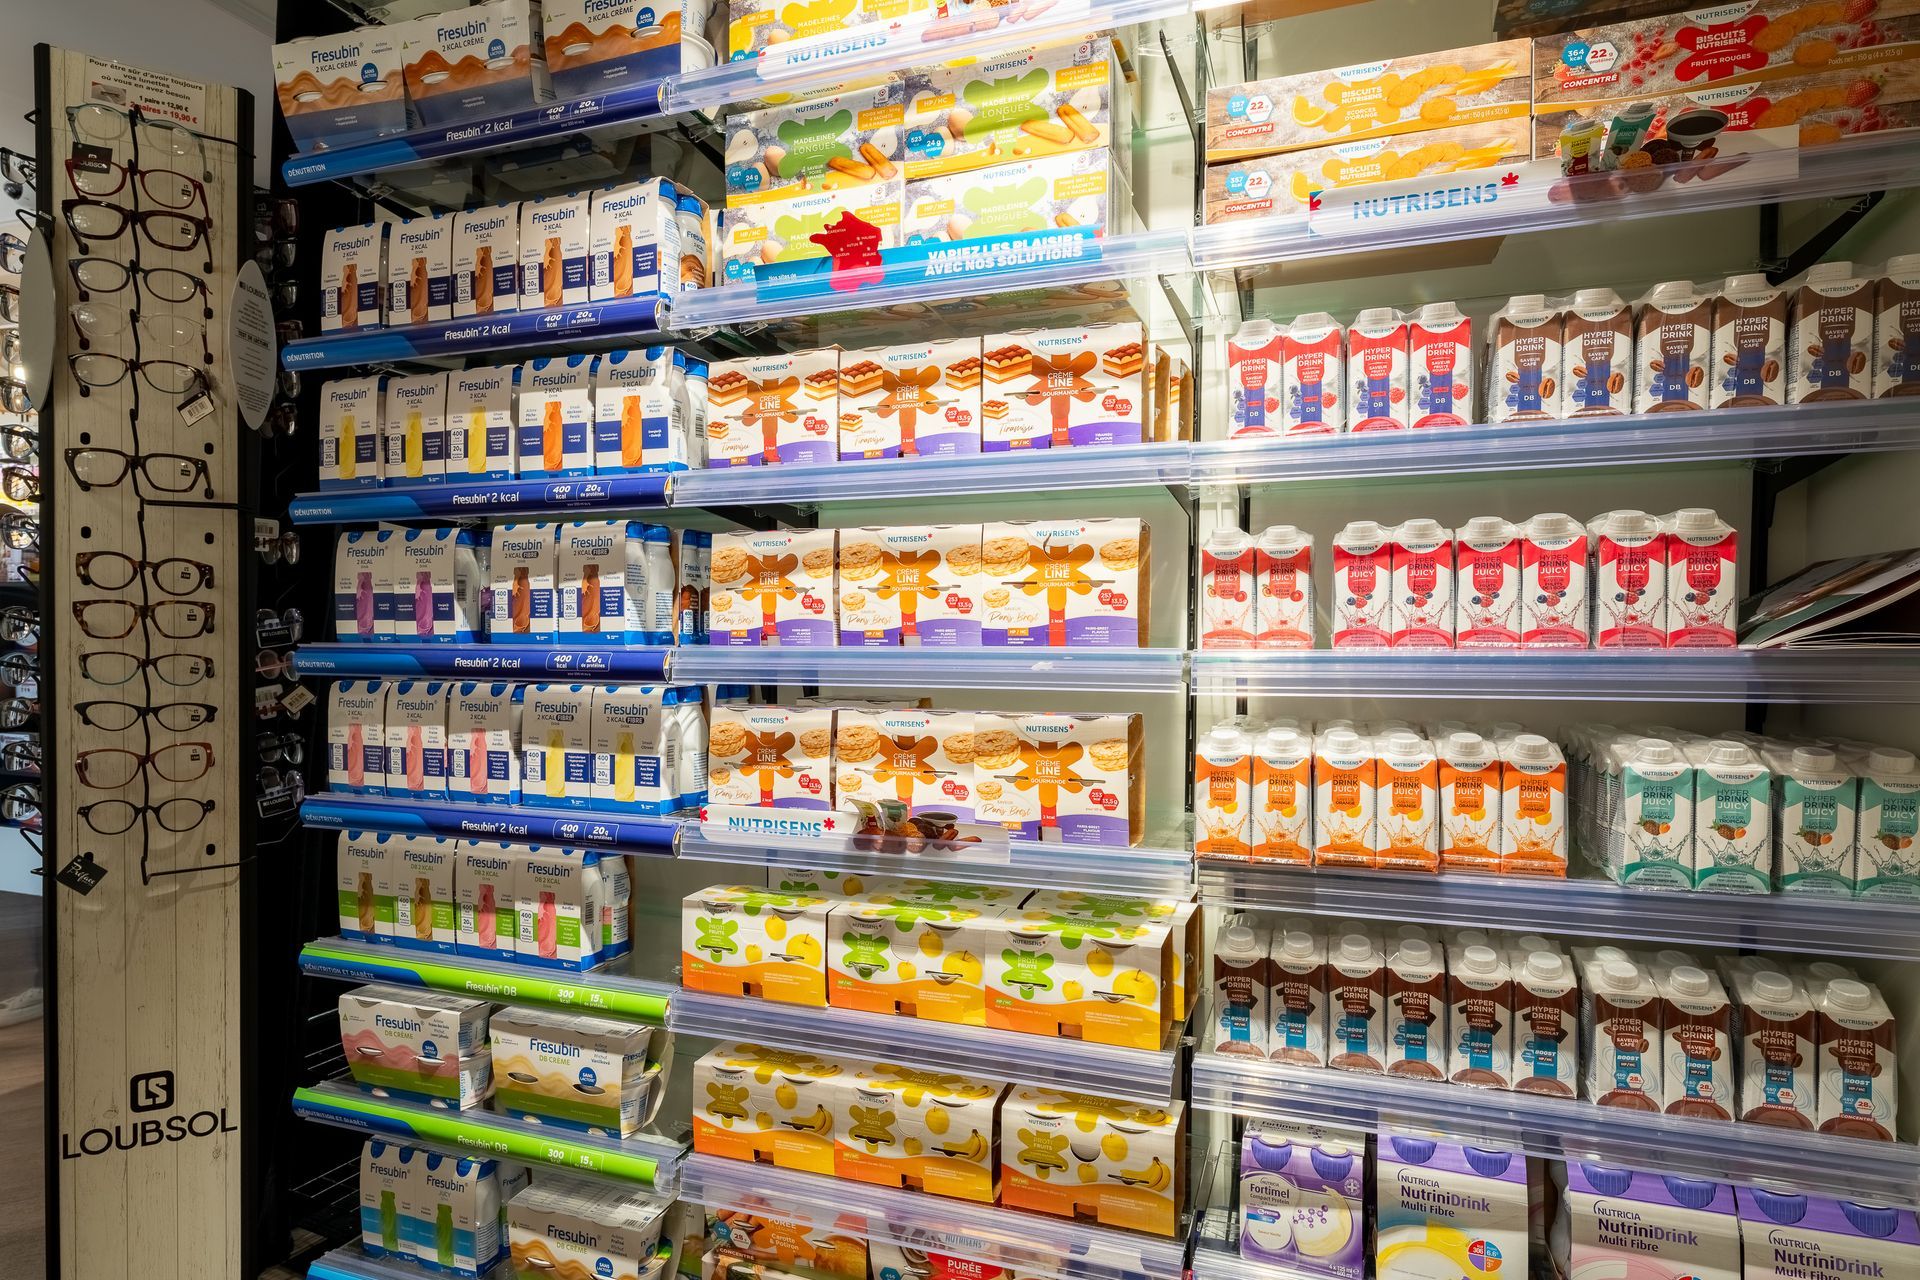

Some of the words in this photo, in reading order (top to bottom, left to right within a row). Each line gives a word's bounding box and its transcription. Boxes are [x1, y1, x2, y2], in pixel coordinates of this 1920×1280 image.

[1696, 6, 1746, 21] NUTRISENS
[1696, 28, 1746, 45] BISCUITS
[786, 31, 888, 65] NUTRISENS
[1696, 35, 1747, 51] NUTRISENS
[1568, 48, 1585, 58] 364
[1590, 49, 1608, 60] 22
[321, 63, 336, 72] KCAL
[337, 59, 358, 70] CRÈME
[1691, 57, 1719, 68] FRUITS
[1720, 52, 1752, 64] ROUGES
[1341, 65, 1382, 78] NUTRISENS
[1563, 73, 1618, 89] CONCENTRÉ
[1342, 86, 1382, 98] BISCUITS
[1342, 93, 1383, 105] NUTRISENS
[546, 105, 564, 114] 400
[795, 98, 836, 114] NUTRISENS
[494, 119, 512, 131] kcal
[1226, 124, 1273, 138] CONCENTRÉ
[794, 132, 836, 146] MADELEINES
[793, 141, 836, 155] LONGUES
[288, 163, 326, 177] DÉNUTRITION
[1353, 183, 1499, 220] NUTRISENS
[927, 247, 977, 264] VARIEZ
[979, 244, 1001, 261] LES
[1002, 233, 1084, 257] PLAISIRS
[925, 259, 963, 277] AVEC
[965, 256, 996, 274] NOS
[998, 244, 1084, 272] SOLUTIONS
[1820, 285, 1855, 293] NUTRISENS
[1820, 307, 1854, 316] HYPER
[543, 314, 562, 322] 400
[1820, 314, 1854, 323] DRINK
[491, 323, 511, 334] kcal
[1038, 336, 1082, 347] NUTRISENS
[1428, 341, 1455, 349] HYPER
[287, 351, 324, 362] DÉNUTRITION
[1428, 348, 1455, 356] DRINK
[1047, 370, 1074, 380] CRÈME
[1048, 378, 1074, 388] LINE
[1042, 390, 1080, 398] GOURMANDE
[552, 485, 571, 494] 400
[491, 494, 497, 503] 2
[500, 491, 519, 503] kcal
[294, 507, 332, 516] DÉNUTRITION
[1687, 535, 1721, 543] NUTRISENS
[522, 551, 539, 559] FIBRE
[1688, 557, 1719, 565] DRINK
[1688, 562, 1719, 572] JUICY
[297, 660, 335, 668] DÉNUTRITION
[493, 657, 499, 667] 2
[501, 657, 520, 668] kcal
[1026, 724, 1069, 734] NUTRISENS
[1036, 766, 1061, 776] LINE
[1520, 762, 1549, 770] NUTRISENS
[1520, 784, 1549, 792] DRINK
[1521, 790, 1549, 800] JUICY
[1643, 791, 1673, 799] DRINK
[1644, 797, 1673, 806] JUICY
[500, 822, 506, 831] 2
[509, 824, 528, 835] kcal
[560, 824, 579, 832] 400
[728, 815, 822, 838] NUTRISENS
[503, 985, 517, 996] DB
[557, 989, 575, 998] 300
[1682, 1025, 1713, 1034] HYPER
[1682, 1031, 1714, 1041] DRINK
[539, 1055, 548, 1064] DB
[549, 1055, 570, 1067] CRÈME
[1687, 1062, 1712, 1070] BOOST
[62, 1108, 237, 1159] LOUBSOL
[1401, 1175, 1440, 1188] NUTRICIA
[1250, 1183, 1290, 1199] Fortimel
[1400, 1185, 1491, 1213] NutriniDrink
[1401, 1201, 1427, 1213] Multi
[1430, 1205, 1455, 1218] Fibre
[1597, 1206, 1642, 1221] NUTRICIA
[547, 1224, 598, 1247] Fresubin
[1598, 1217, 1699, 1247] NutriniDrink
[1598, 1233, 1628, 1246] Multi
[1631, 1238, 1659, 1253] Fibre
[1773, 1236, 1821, 1252] NUTRICIA
[947, 1258, 982, 1272] PURÉE
[1774, 1249, 1884, 1278] NutriniDrink
[1775, 1266, 1807, 1280] Multi
